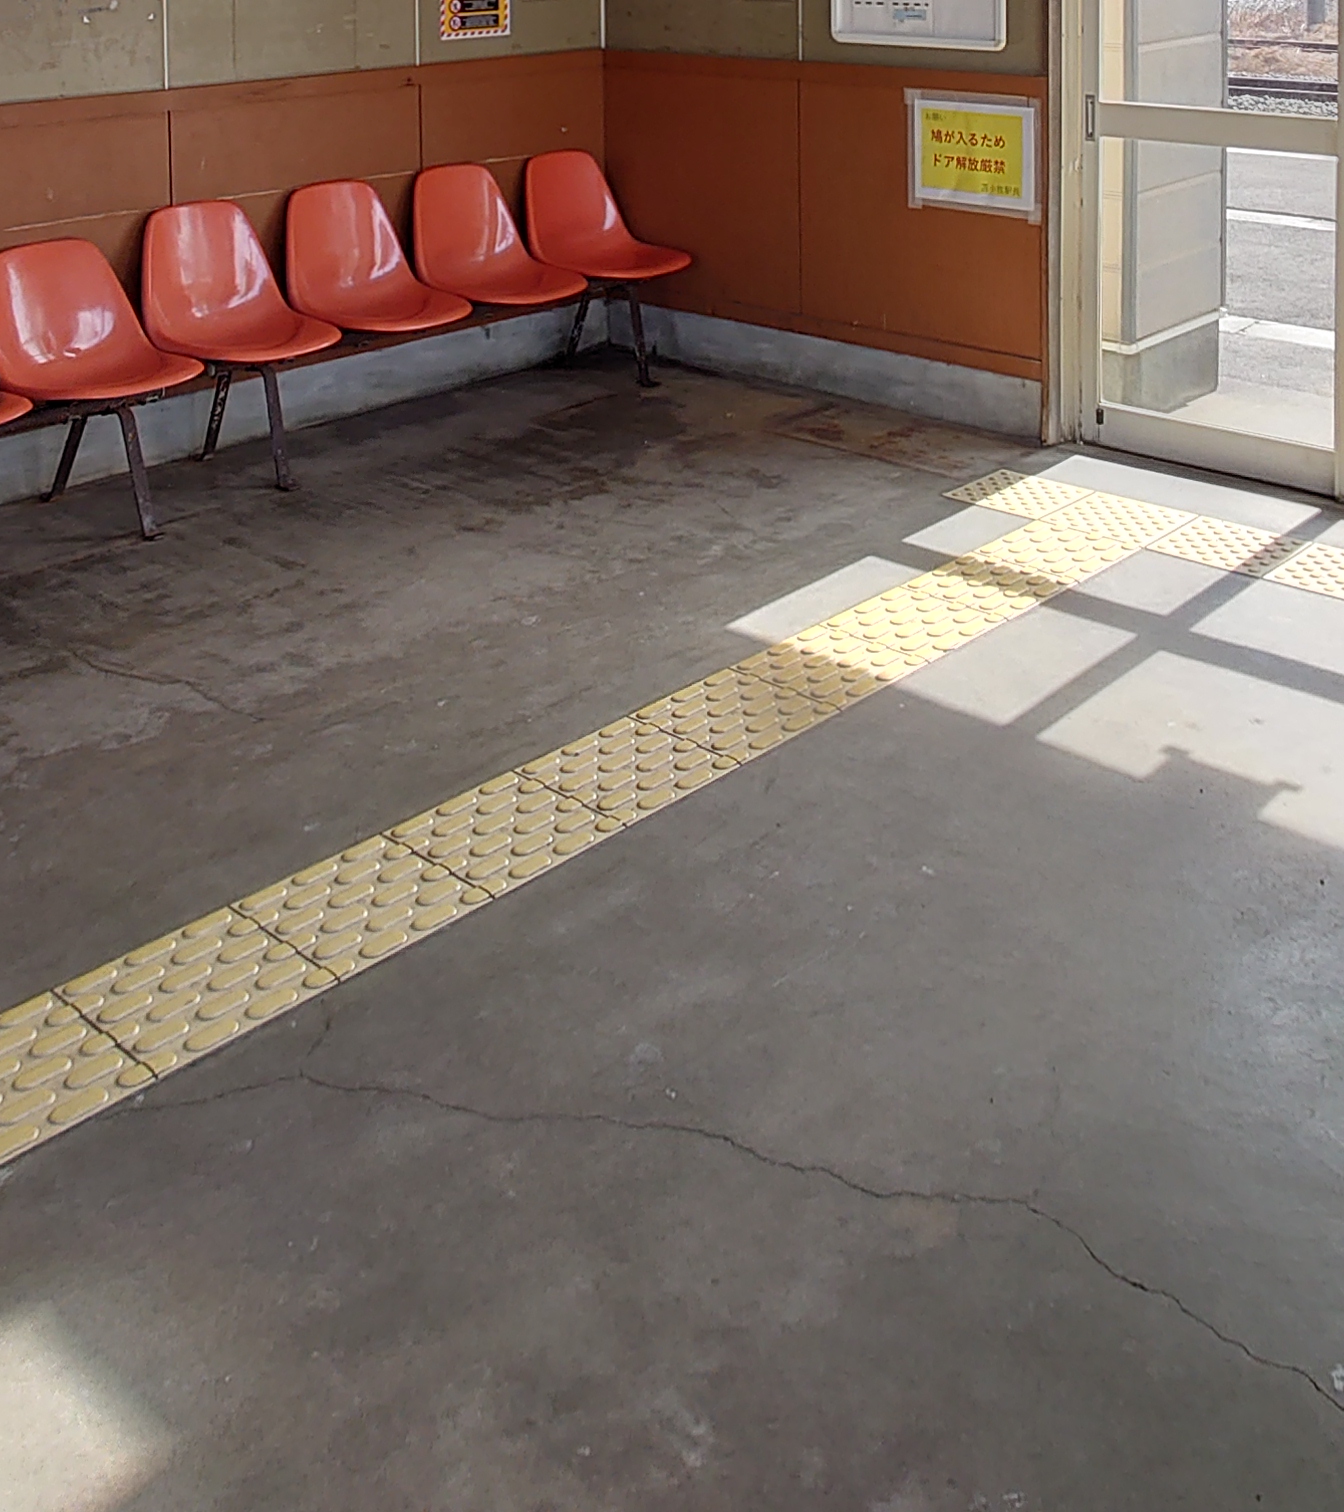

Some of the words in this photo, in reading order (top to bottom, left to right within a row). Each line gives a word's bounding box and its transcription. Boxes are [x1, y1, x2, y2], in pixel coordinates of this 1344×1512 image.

[931, 129, 1006, 148] 鳩が入るため
[933, 153, 1006, 174] ドア解放厳禁
